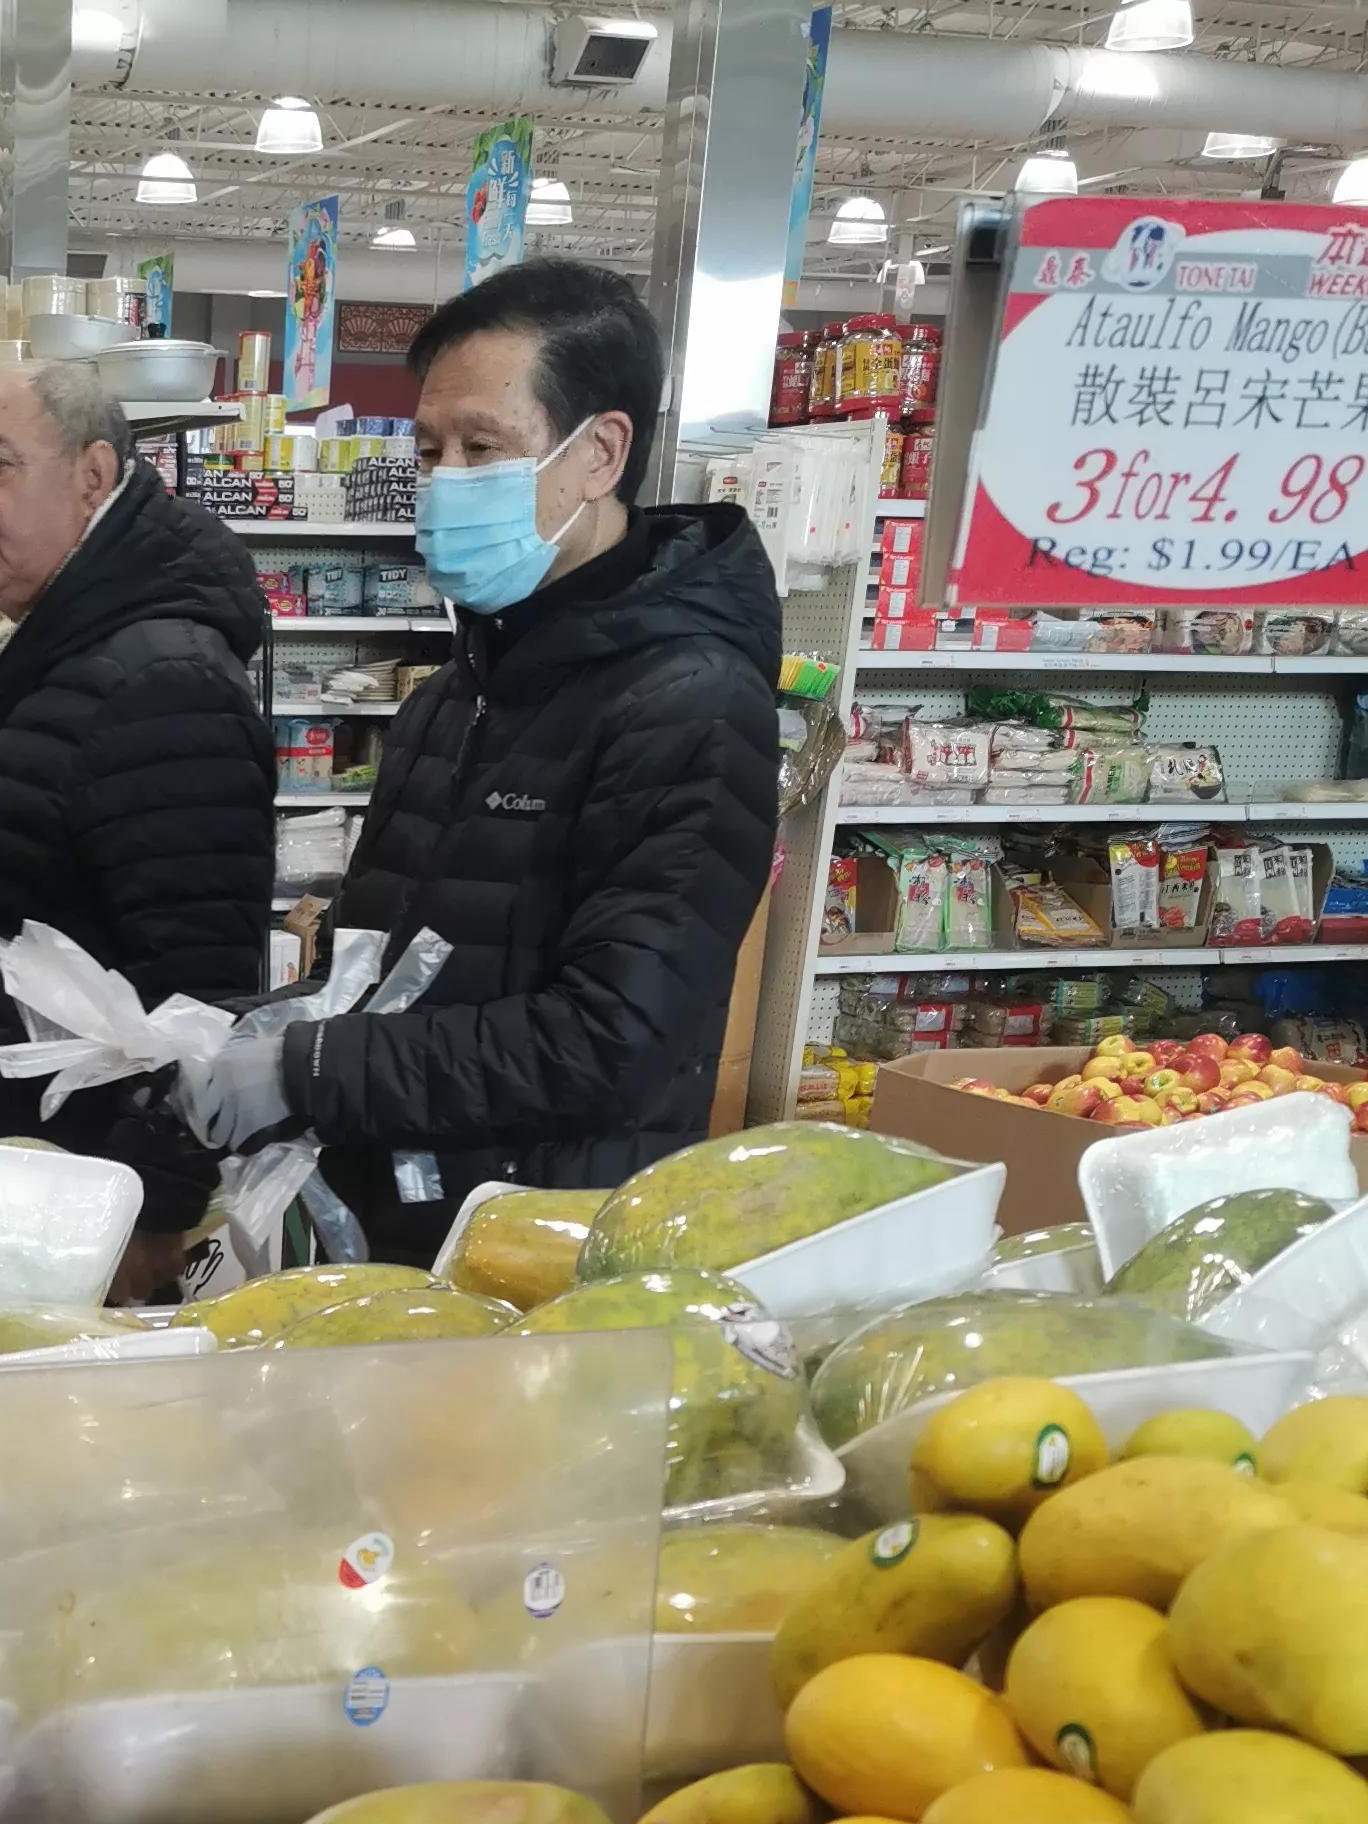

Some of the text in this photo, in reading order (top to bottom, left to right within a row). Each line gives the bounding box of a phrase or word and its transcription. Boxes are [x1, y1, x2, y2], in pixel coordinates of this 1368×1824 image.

[1178, 265, 1224, 288] TONE
[1065, 294, 1213, 352] Ataulfo
[1224, 300, 1330, 364] Mango
[202, 478, 253, 488] ALCAN
[202, 492, 253, 502] ALCAN
[217, 505, 267, 515] ALCAN
[1024, 536, 1358, 578] Reg: $1.99/EA
